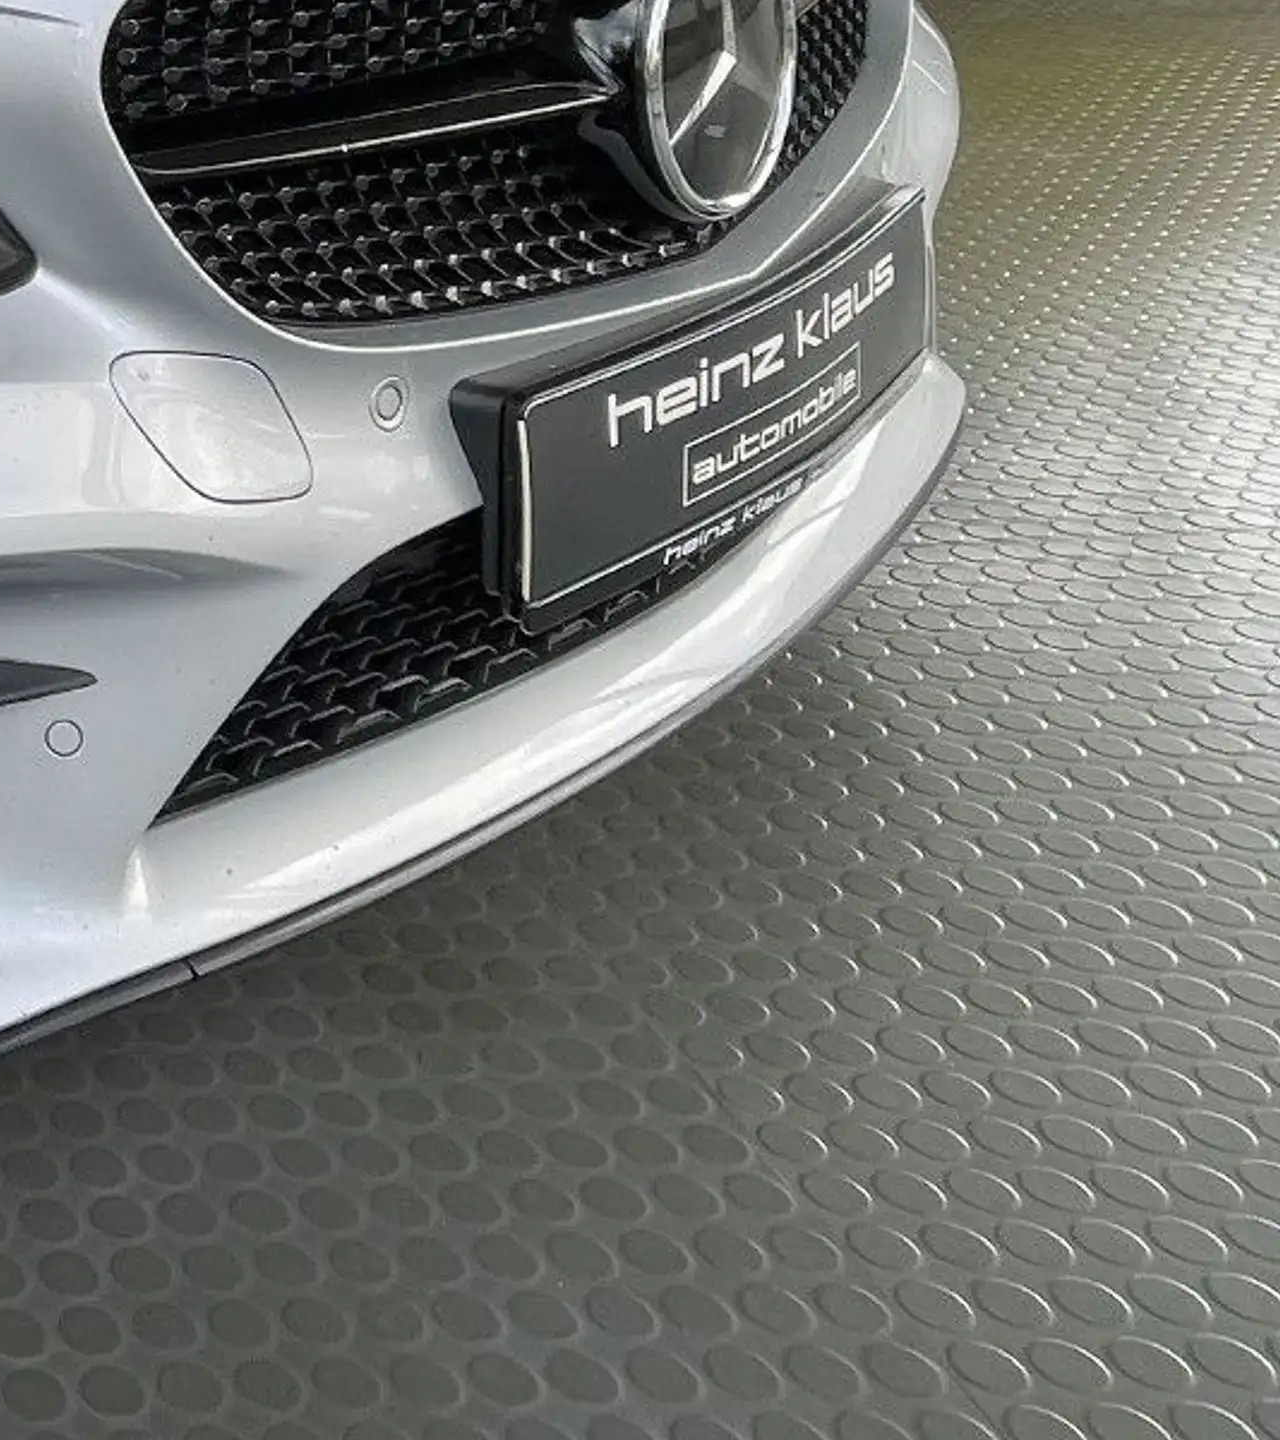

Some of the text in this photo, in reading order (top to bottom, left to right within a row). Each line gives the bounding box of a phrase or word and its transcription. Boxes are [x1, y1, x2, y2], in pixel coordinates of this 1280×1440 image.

[608, 252, 894, 447] heinz klaus
[692, 369, 856, 484] automobile
[662, 515, 737, 566] heinz
